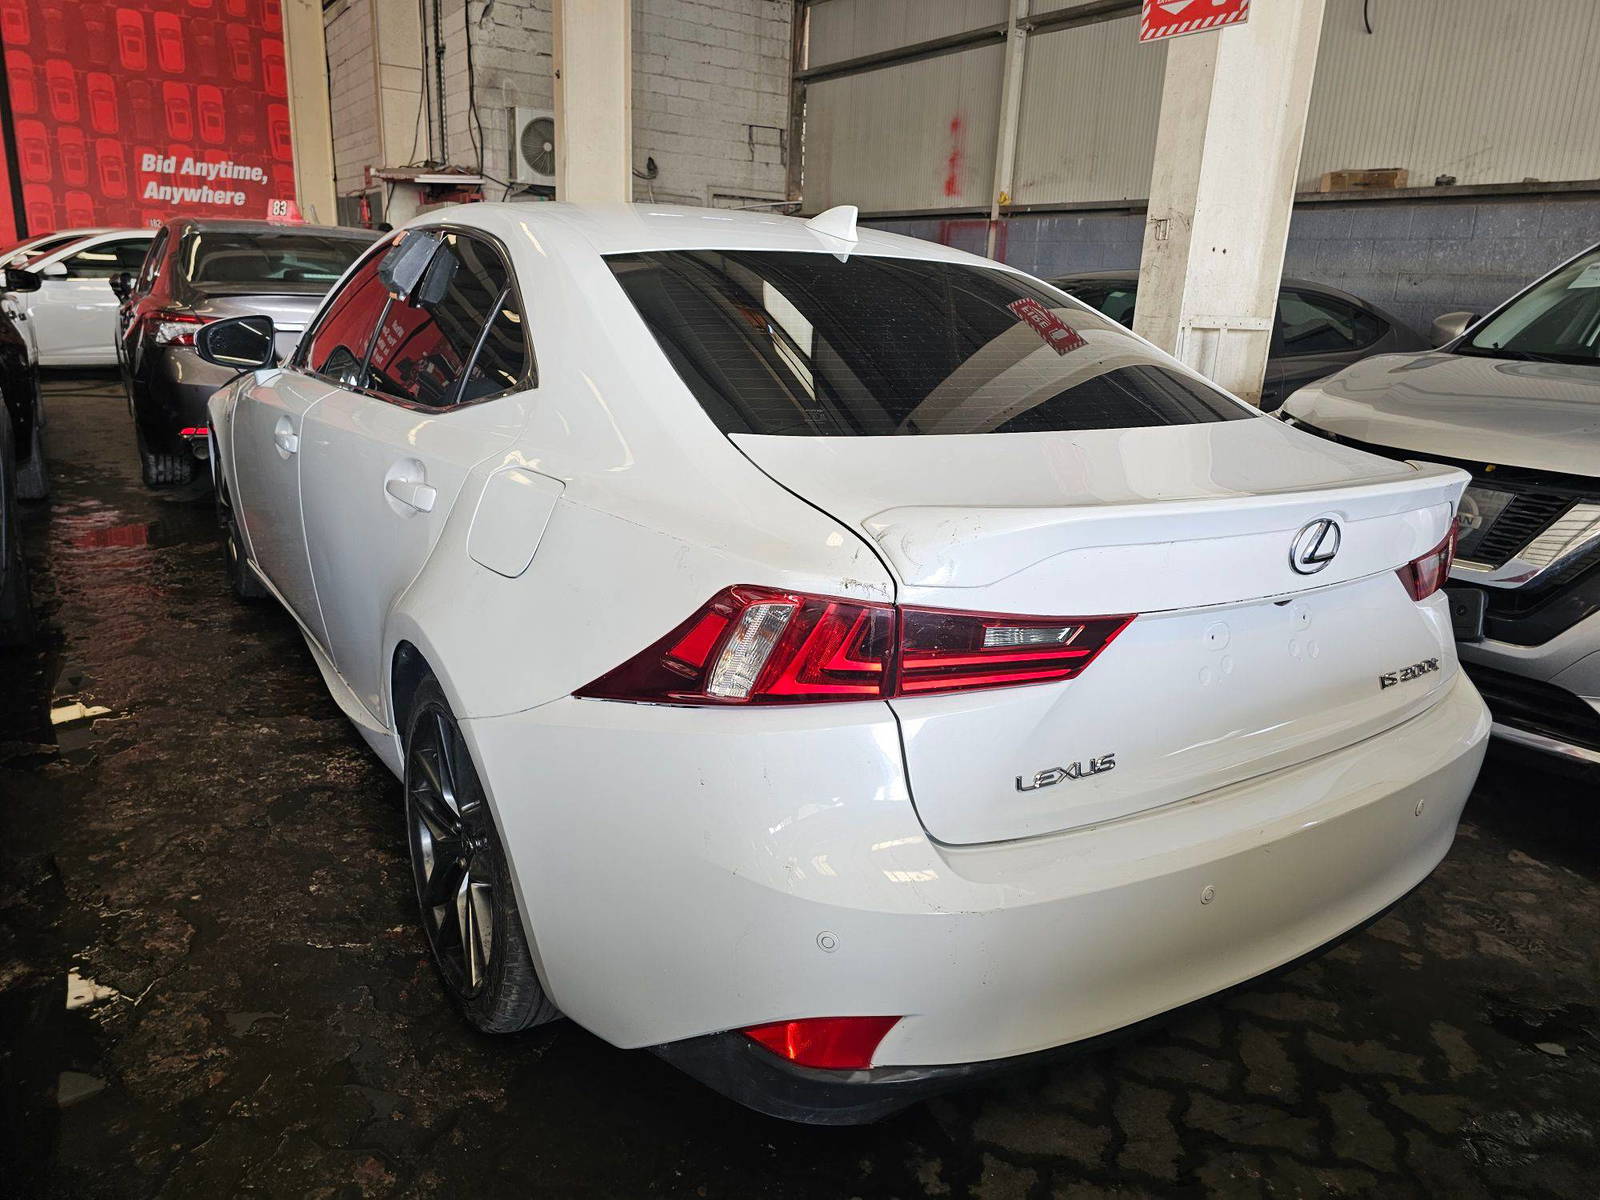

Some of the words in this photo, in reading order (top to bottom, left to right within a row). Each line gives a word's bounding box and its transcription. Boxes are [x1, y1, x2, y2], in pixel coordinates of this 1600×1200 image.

[141, 153, 177, 174] Bid
[180, 157, 268, 185] Anytime,
[143, 181, 246, 206] Anywhere
[272, 200, 287, 217] 83
[1379, 671, 1398, 690] IS
[1015, 752, 1116, 793] LEXUS
